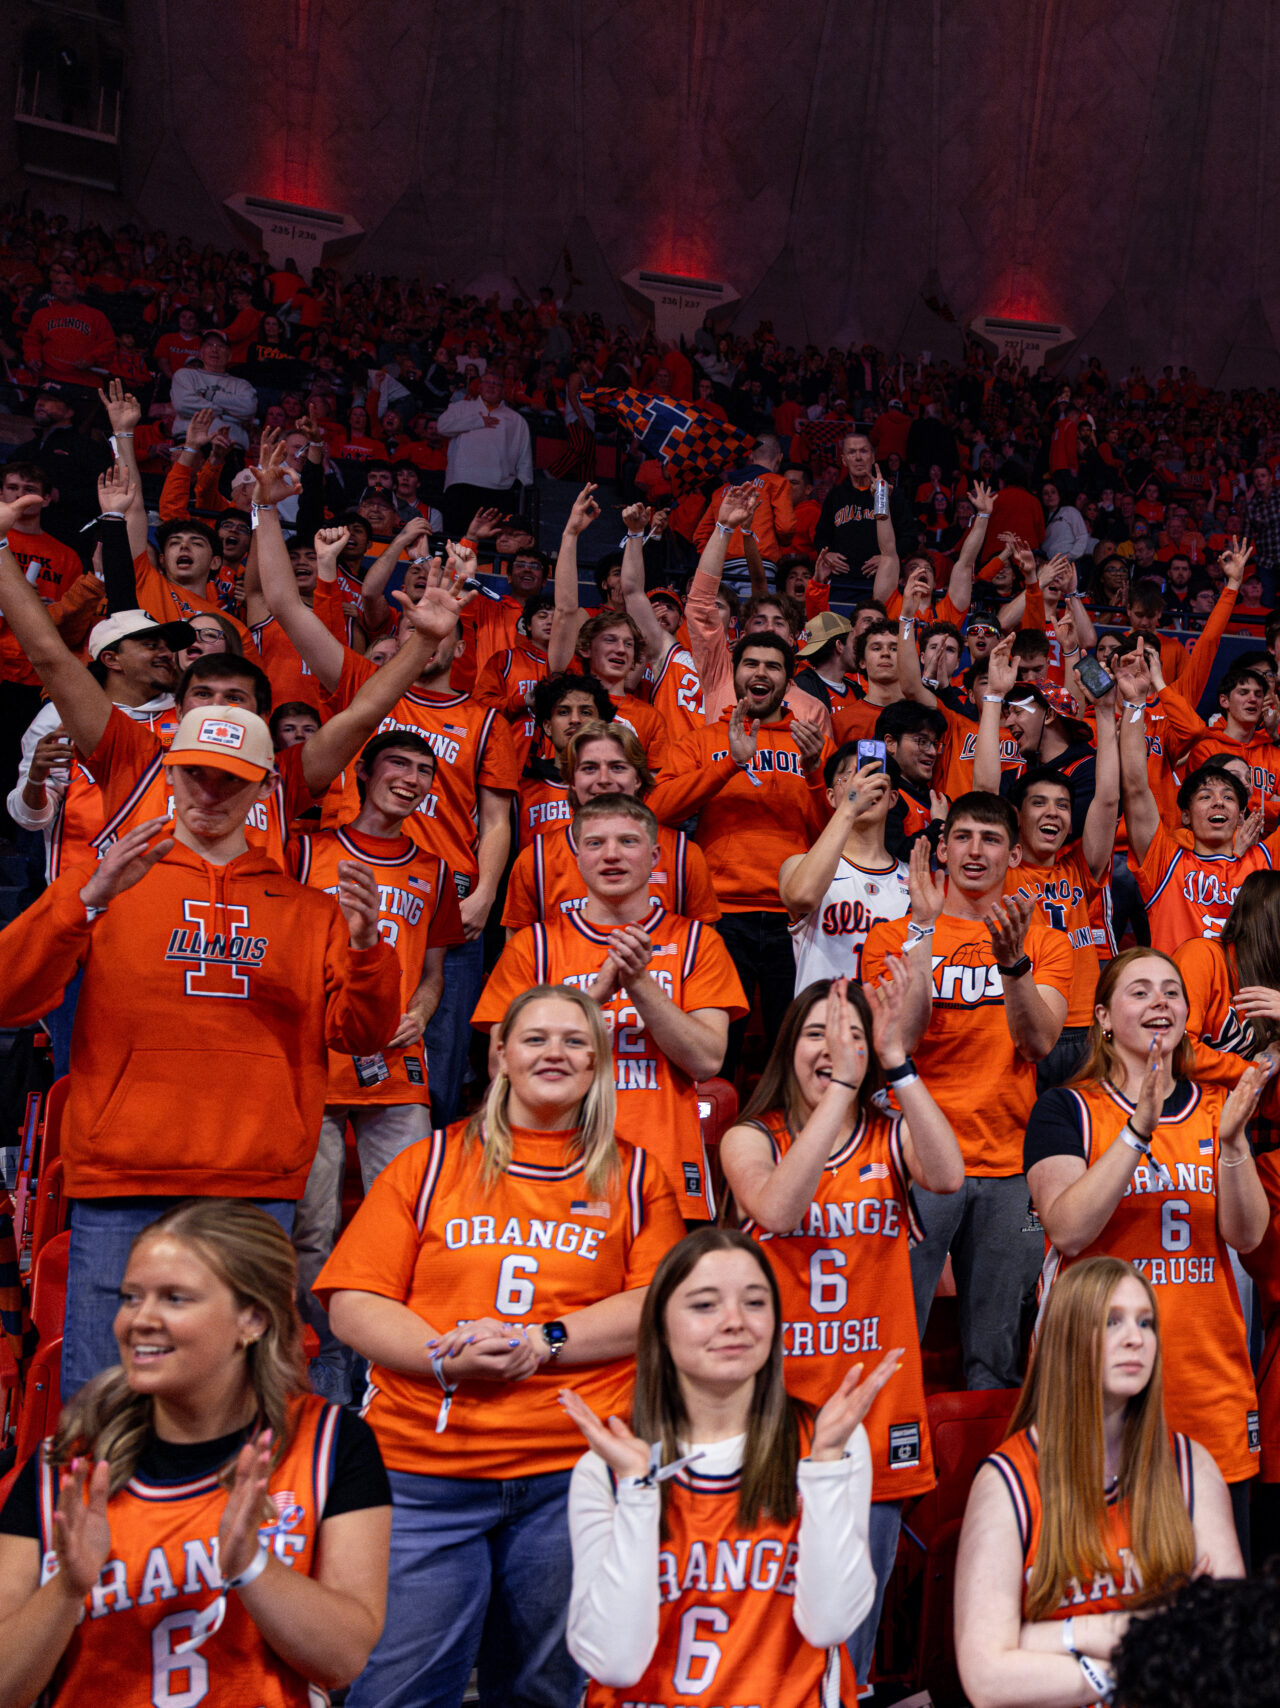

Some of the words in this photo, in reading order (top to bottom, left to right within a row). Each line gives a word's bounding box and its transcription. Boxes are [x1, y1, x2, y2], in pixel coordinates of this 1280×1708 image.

[47, 318, 92, 337] ILLINOIS
[528, 799, 570, 829] FIGH
[165, 929, 269, 966] ILLINOIS
[445, 1215, 606, 1261] ORANGE
[1161, 1199, 1191, 1252] 6
[495, 1254, 535, 1316] 6
[810, 1248, 849, 1314] 6
[658, 1539, 799, 1605] RANGE
[673, 1606, 730, 1696] 6
